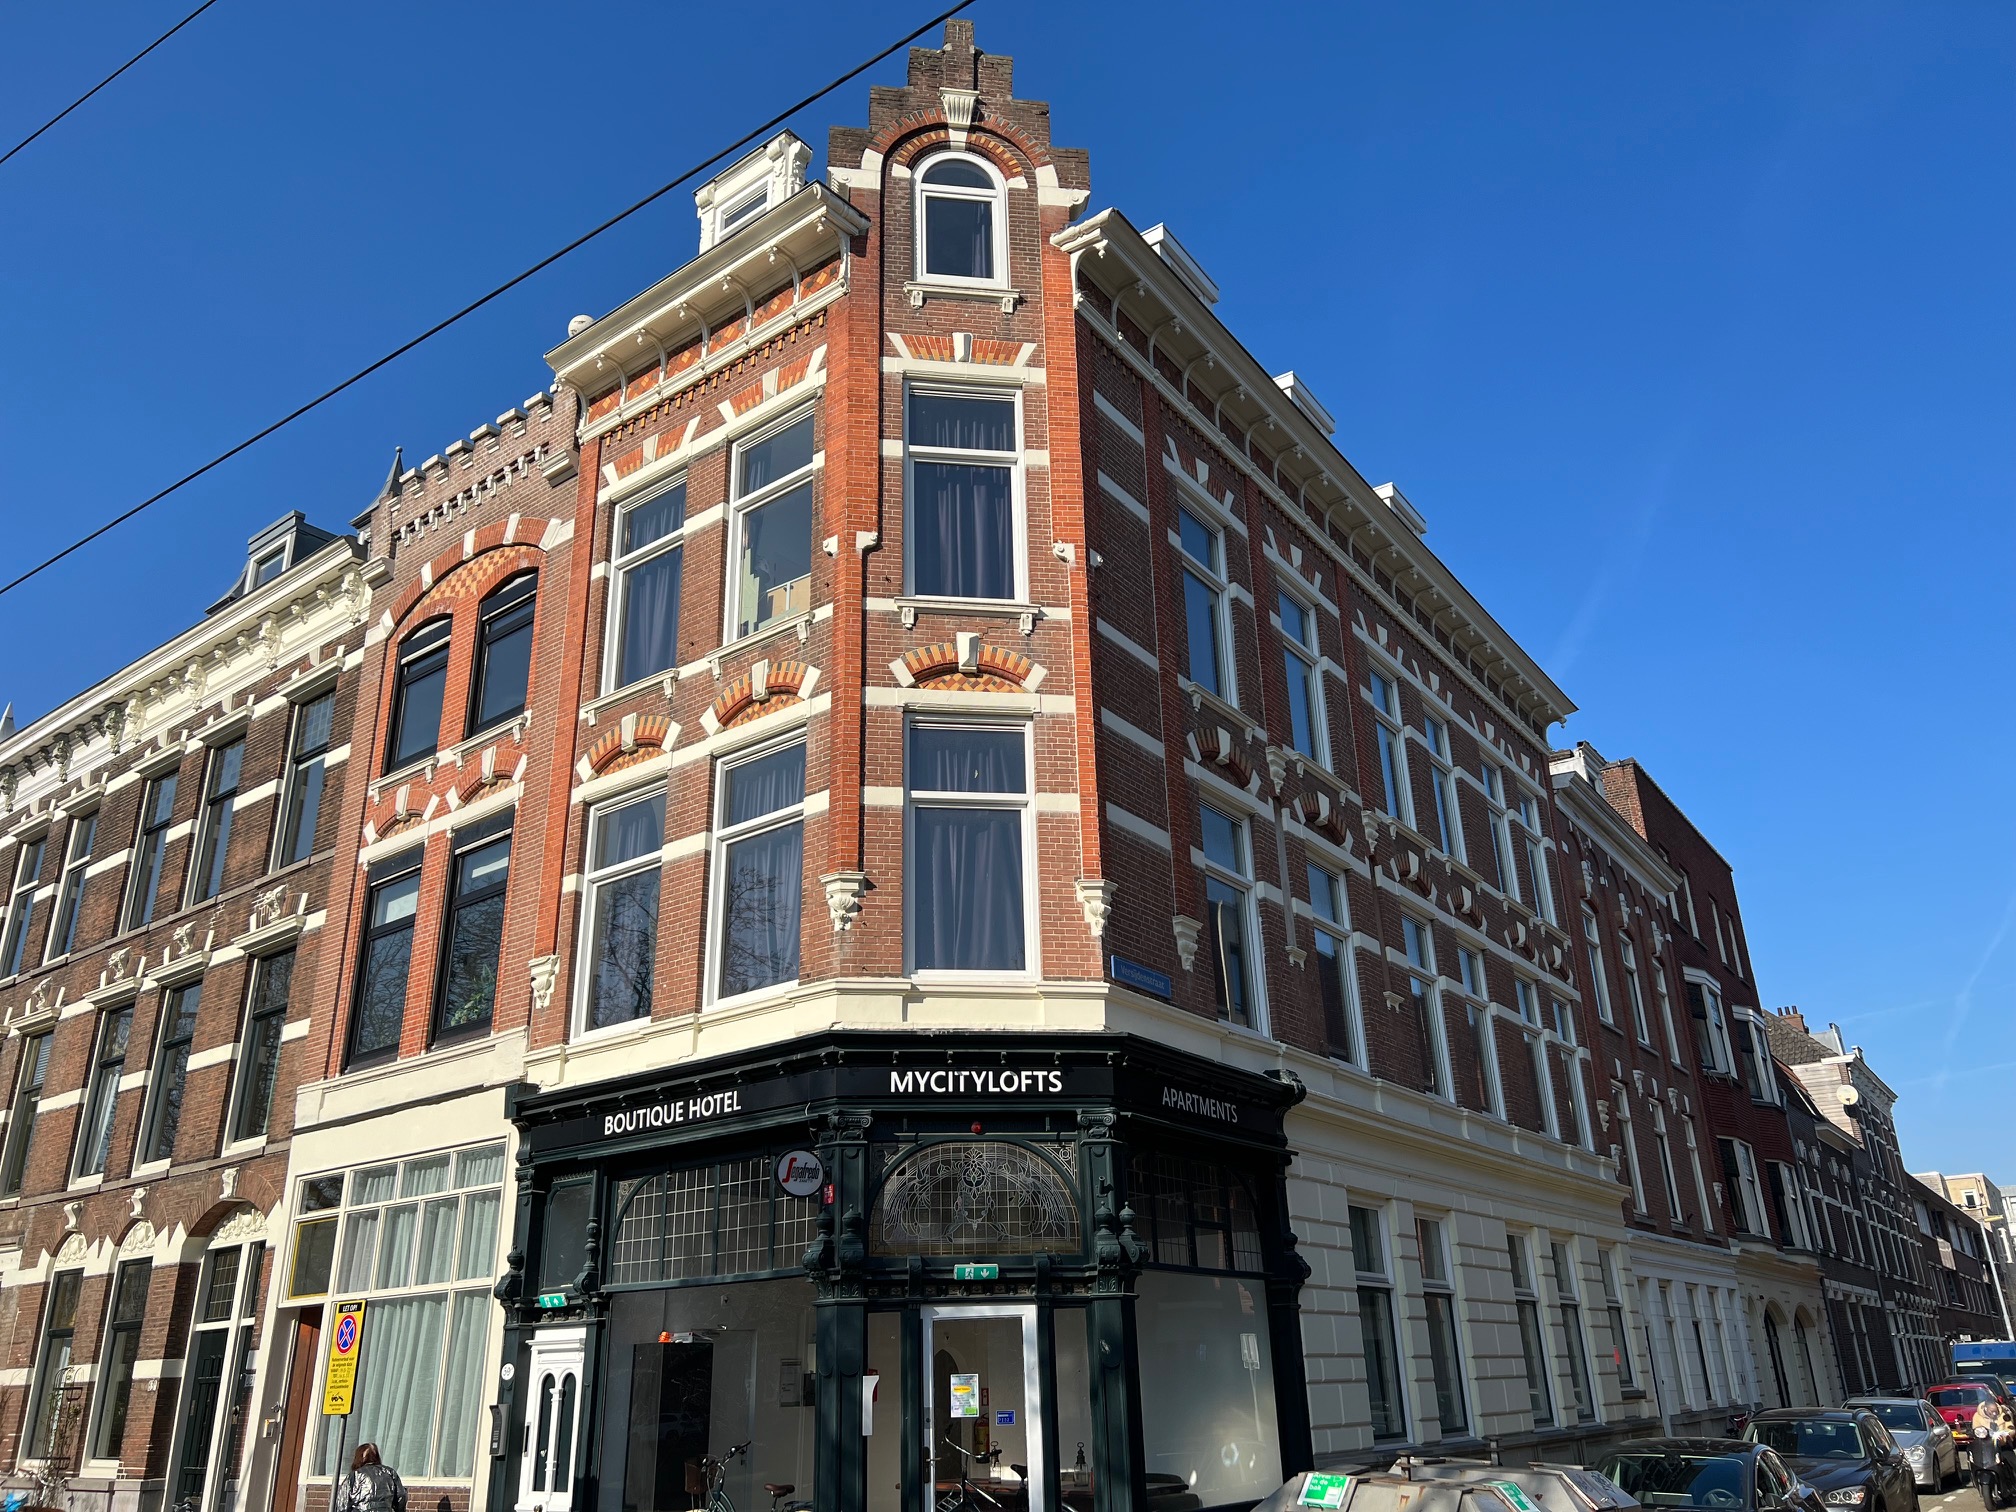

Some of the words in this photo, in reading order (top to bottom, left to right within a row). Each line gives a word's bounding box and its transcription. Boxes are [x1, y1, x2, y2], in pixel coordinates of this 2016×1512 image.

[890, 1070, 1063, 1093] MYCITYLOFTS
[604, 1101, 684, 1135] BOUTIQUE
[688, 1090, 742, 1119] HOTEL
[1162, 1086, 1238, 1123] APARTMENTS
[782, 1157, 820, 1183] Segafredo
